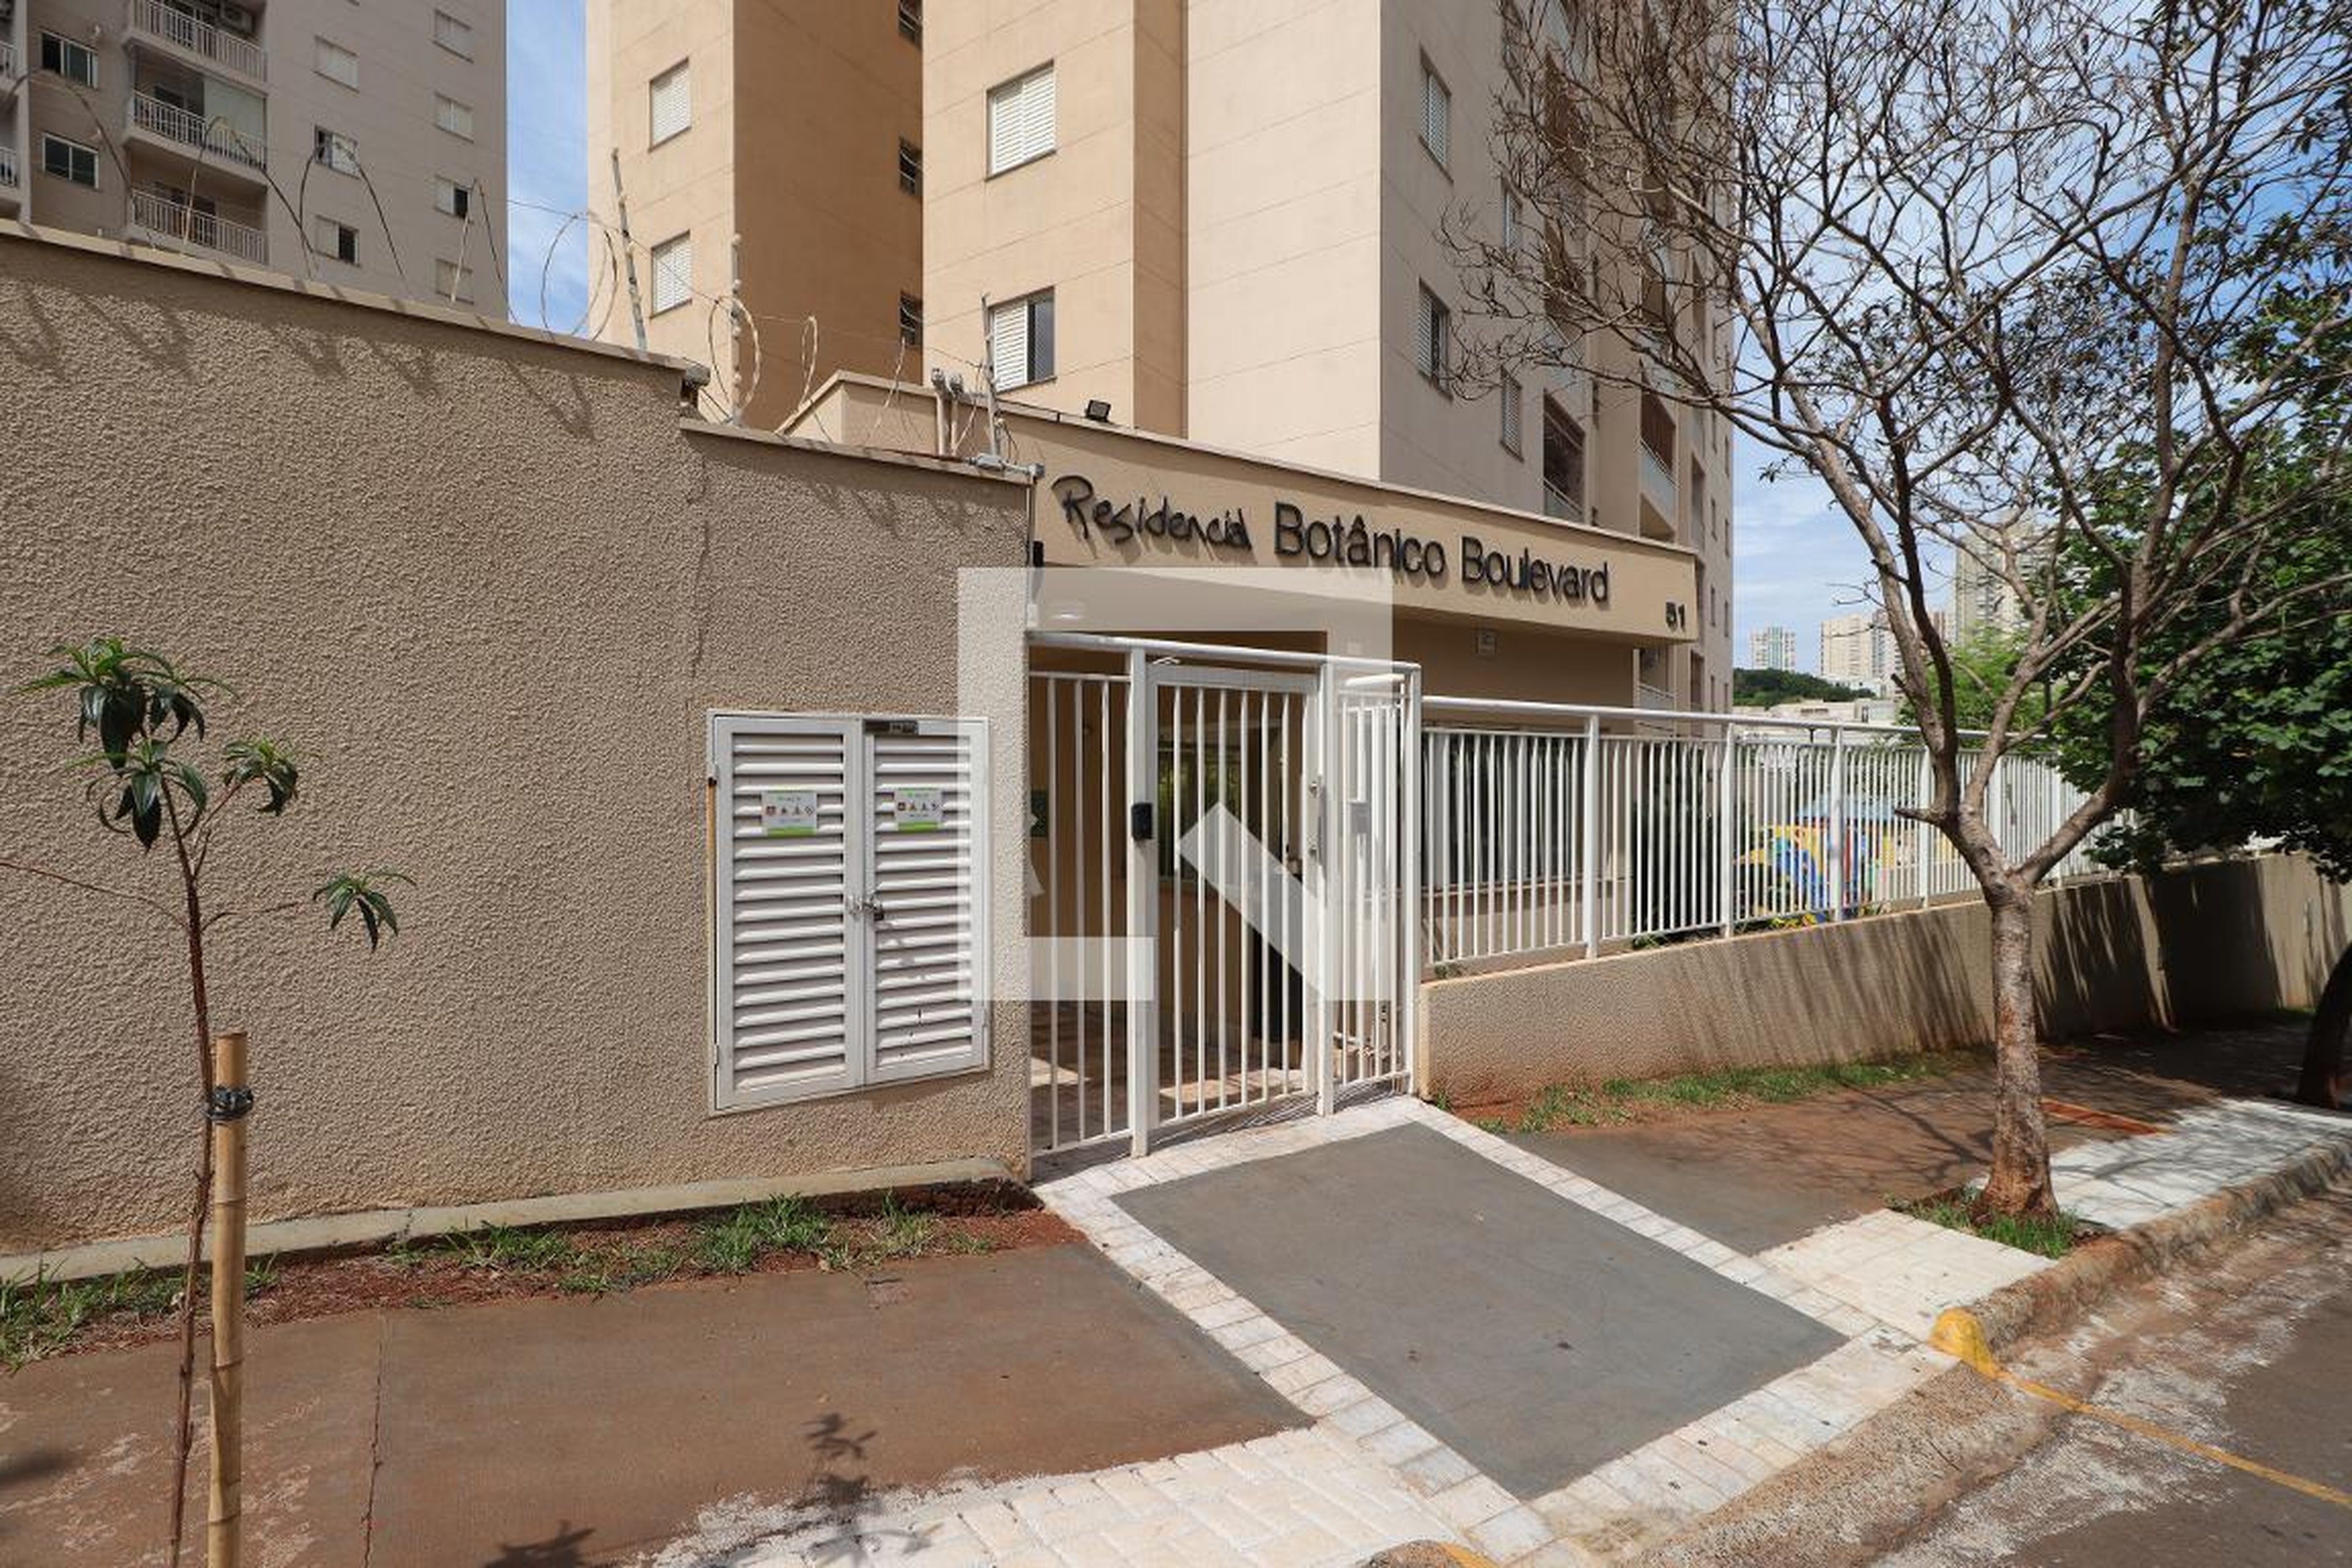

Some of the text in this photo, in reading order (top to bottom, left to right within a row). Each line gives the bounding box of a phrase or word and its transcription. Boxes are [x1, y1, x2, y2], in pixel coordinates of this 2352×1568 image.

[1051, 475, 1608, 603] Residencial Botânico Boulevard
